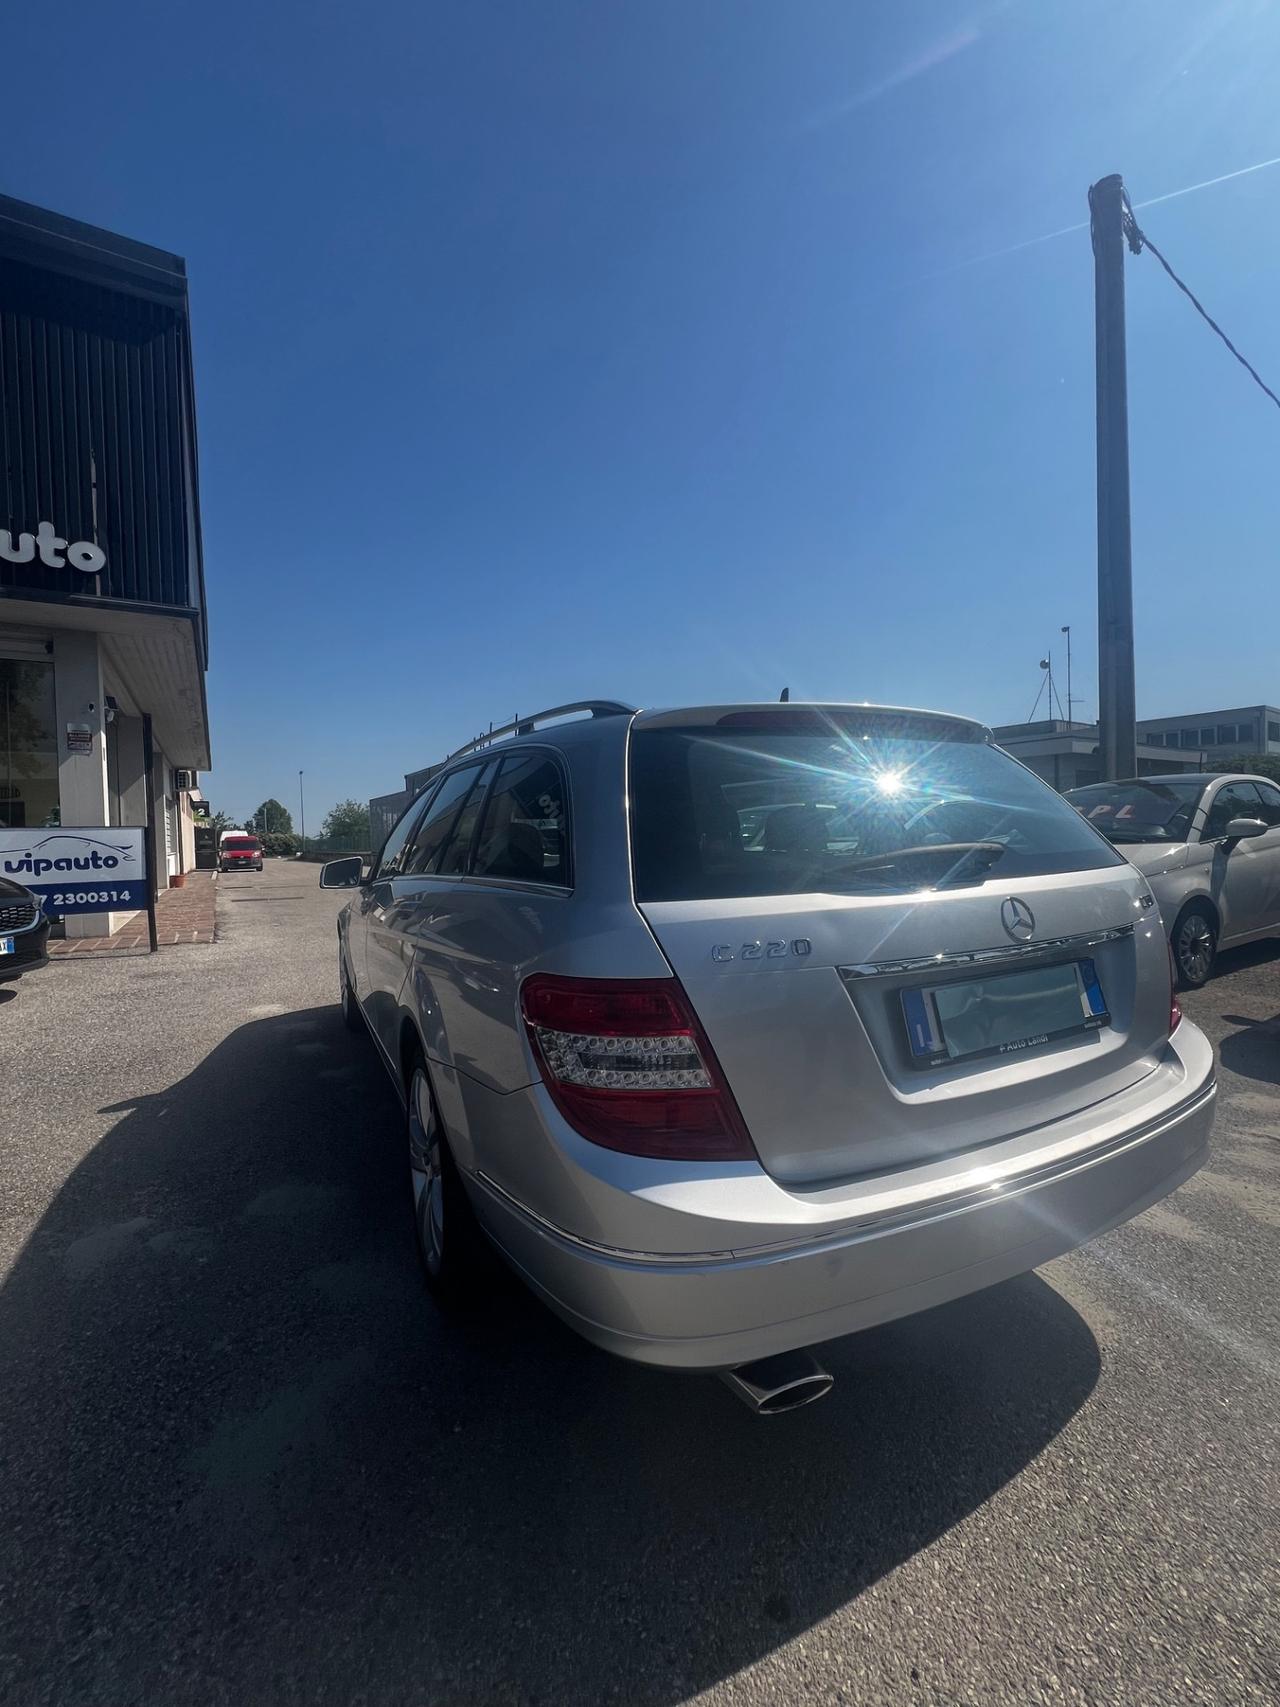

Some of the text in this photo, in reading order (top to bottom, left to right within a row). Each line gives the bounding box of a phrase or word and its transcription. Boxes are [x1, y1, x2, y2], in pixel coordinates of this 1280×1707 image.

[4, 850, 119, 877] vipauto
[53, 890, 131, 905] 2300314
[741, 938, 812, 960] 220
